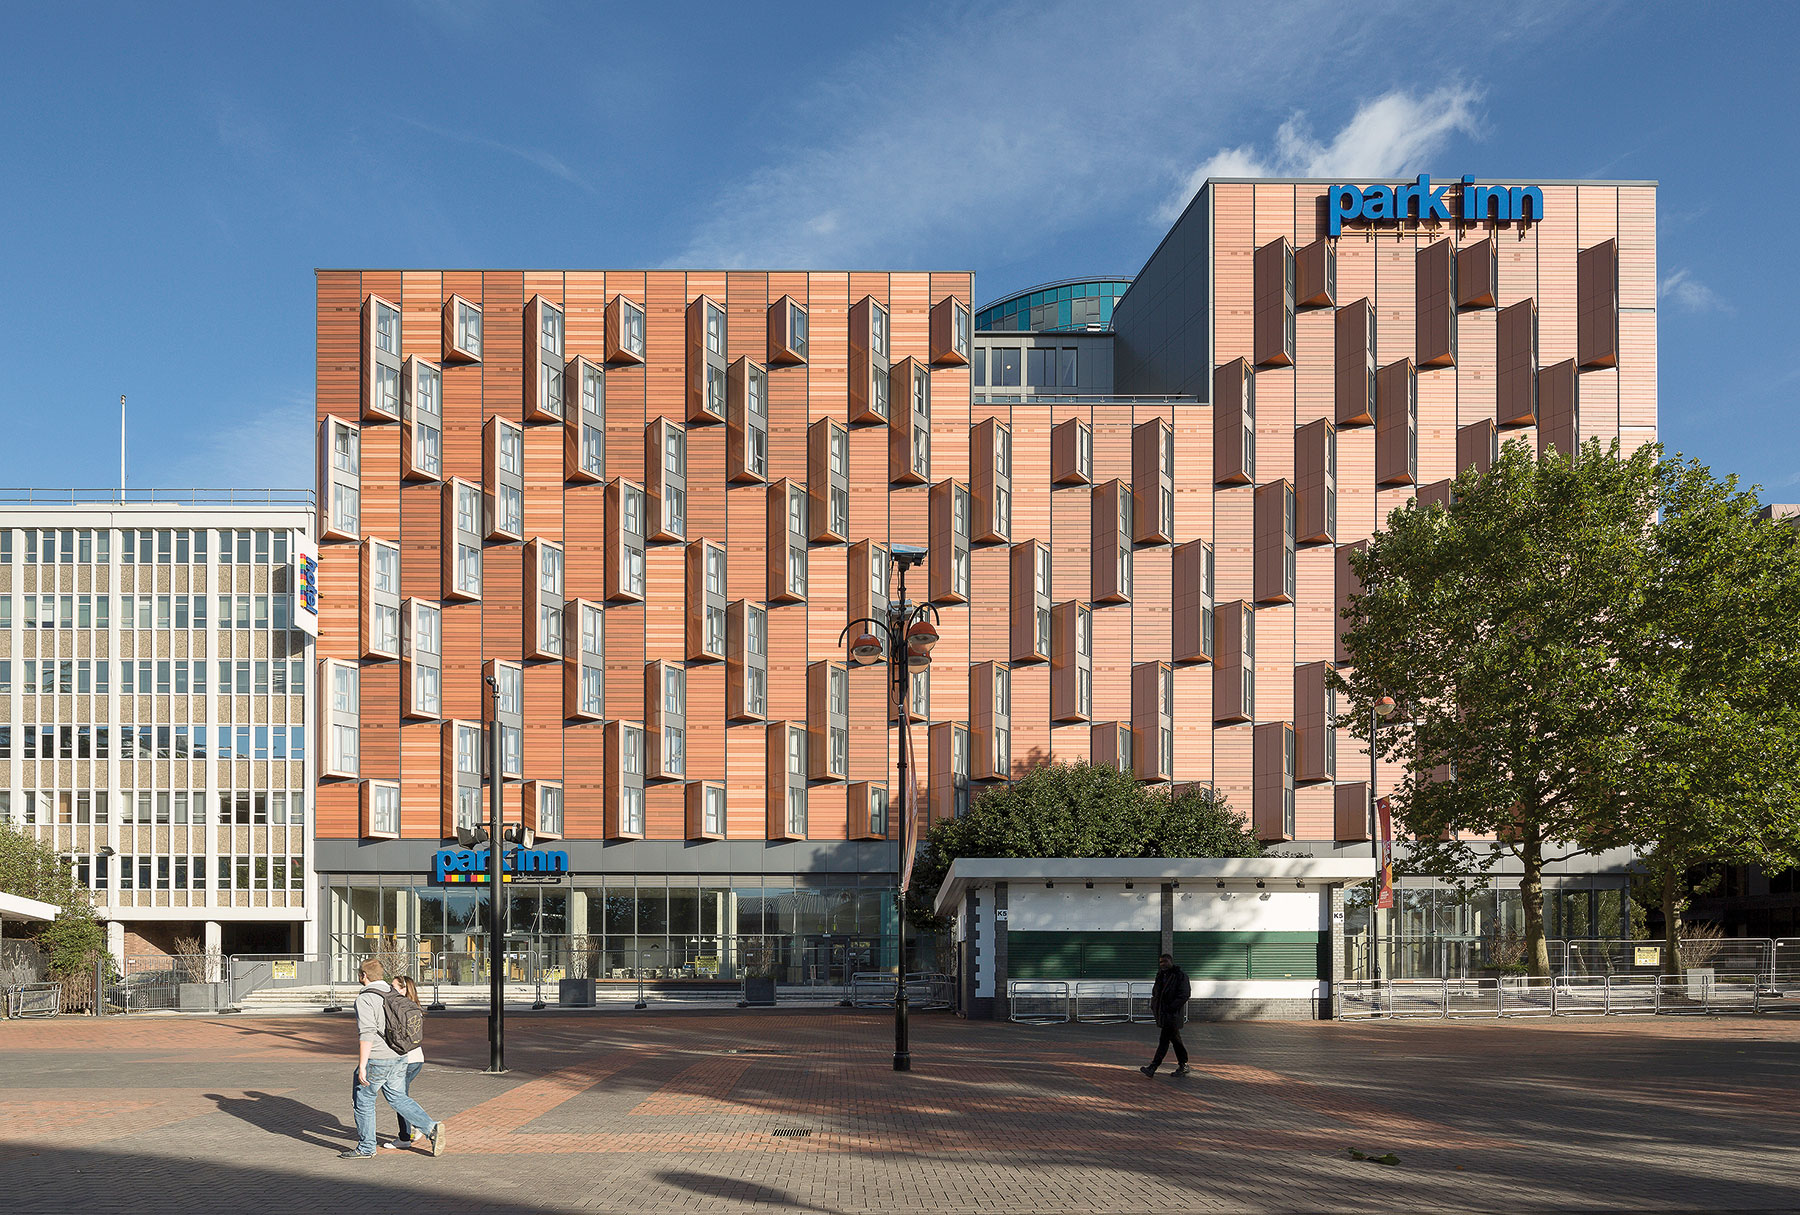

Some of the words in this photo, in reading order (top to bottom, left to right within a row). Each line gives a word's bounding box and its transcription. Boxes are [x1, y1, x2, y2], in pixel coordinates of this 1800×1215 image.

[1328, 174, 1452, 237] park
[1461, 174, 1544, 222] inn
[306, 556, 318, 615] hotel
[517, 844, 568, 872] inn
